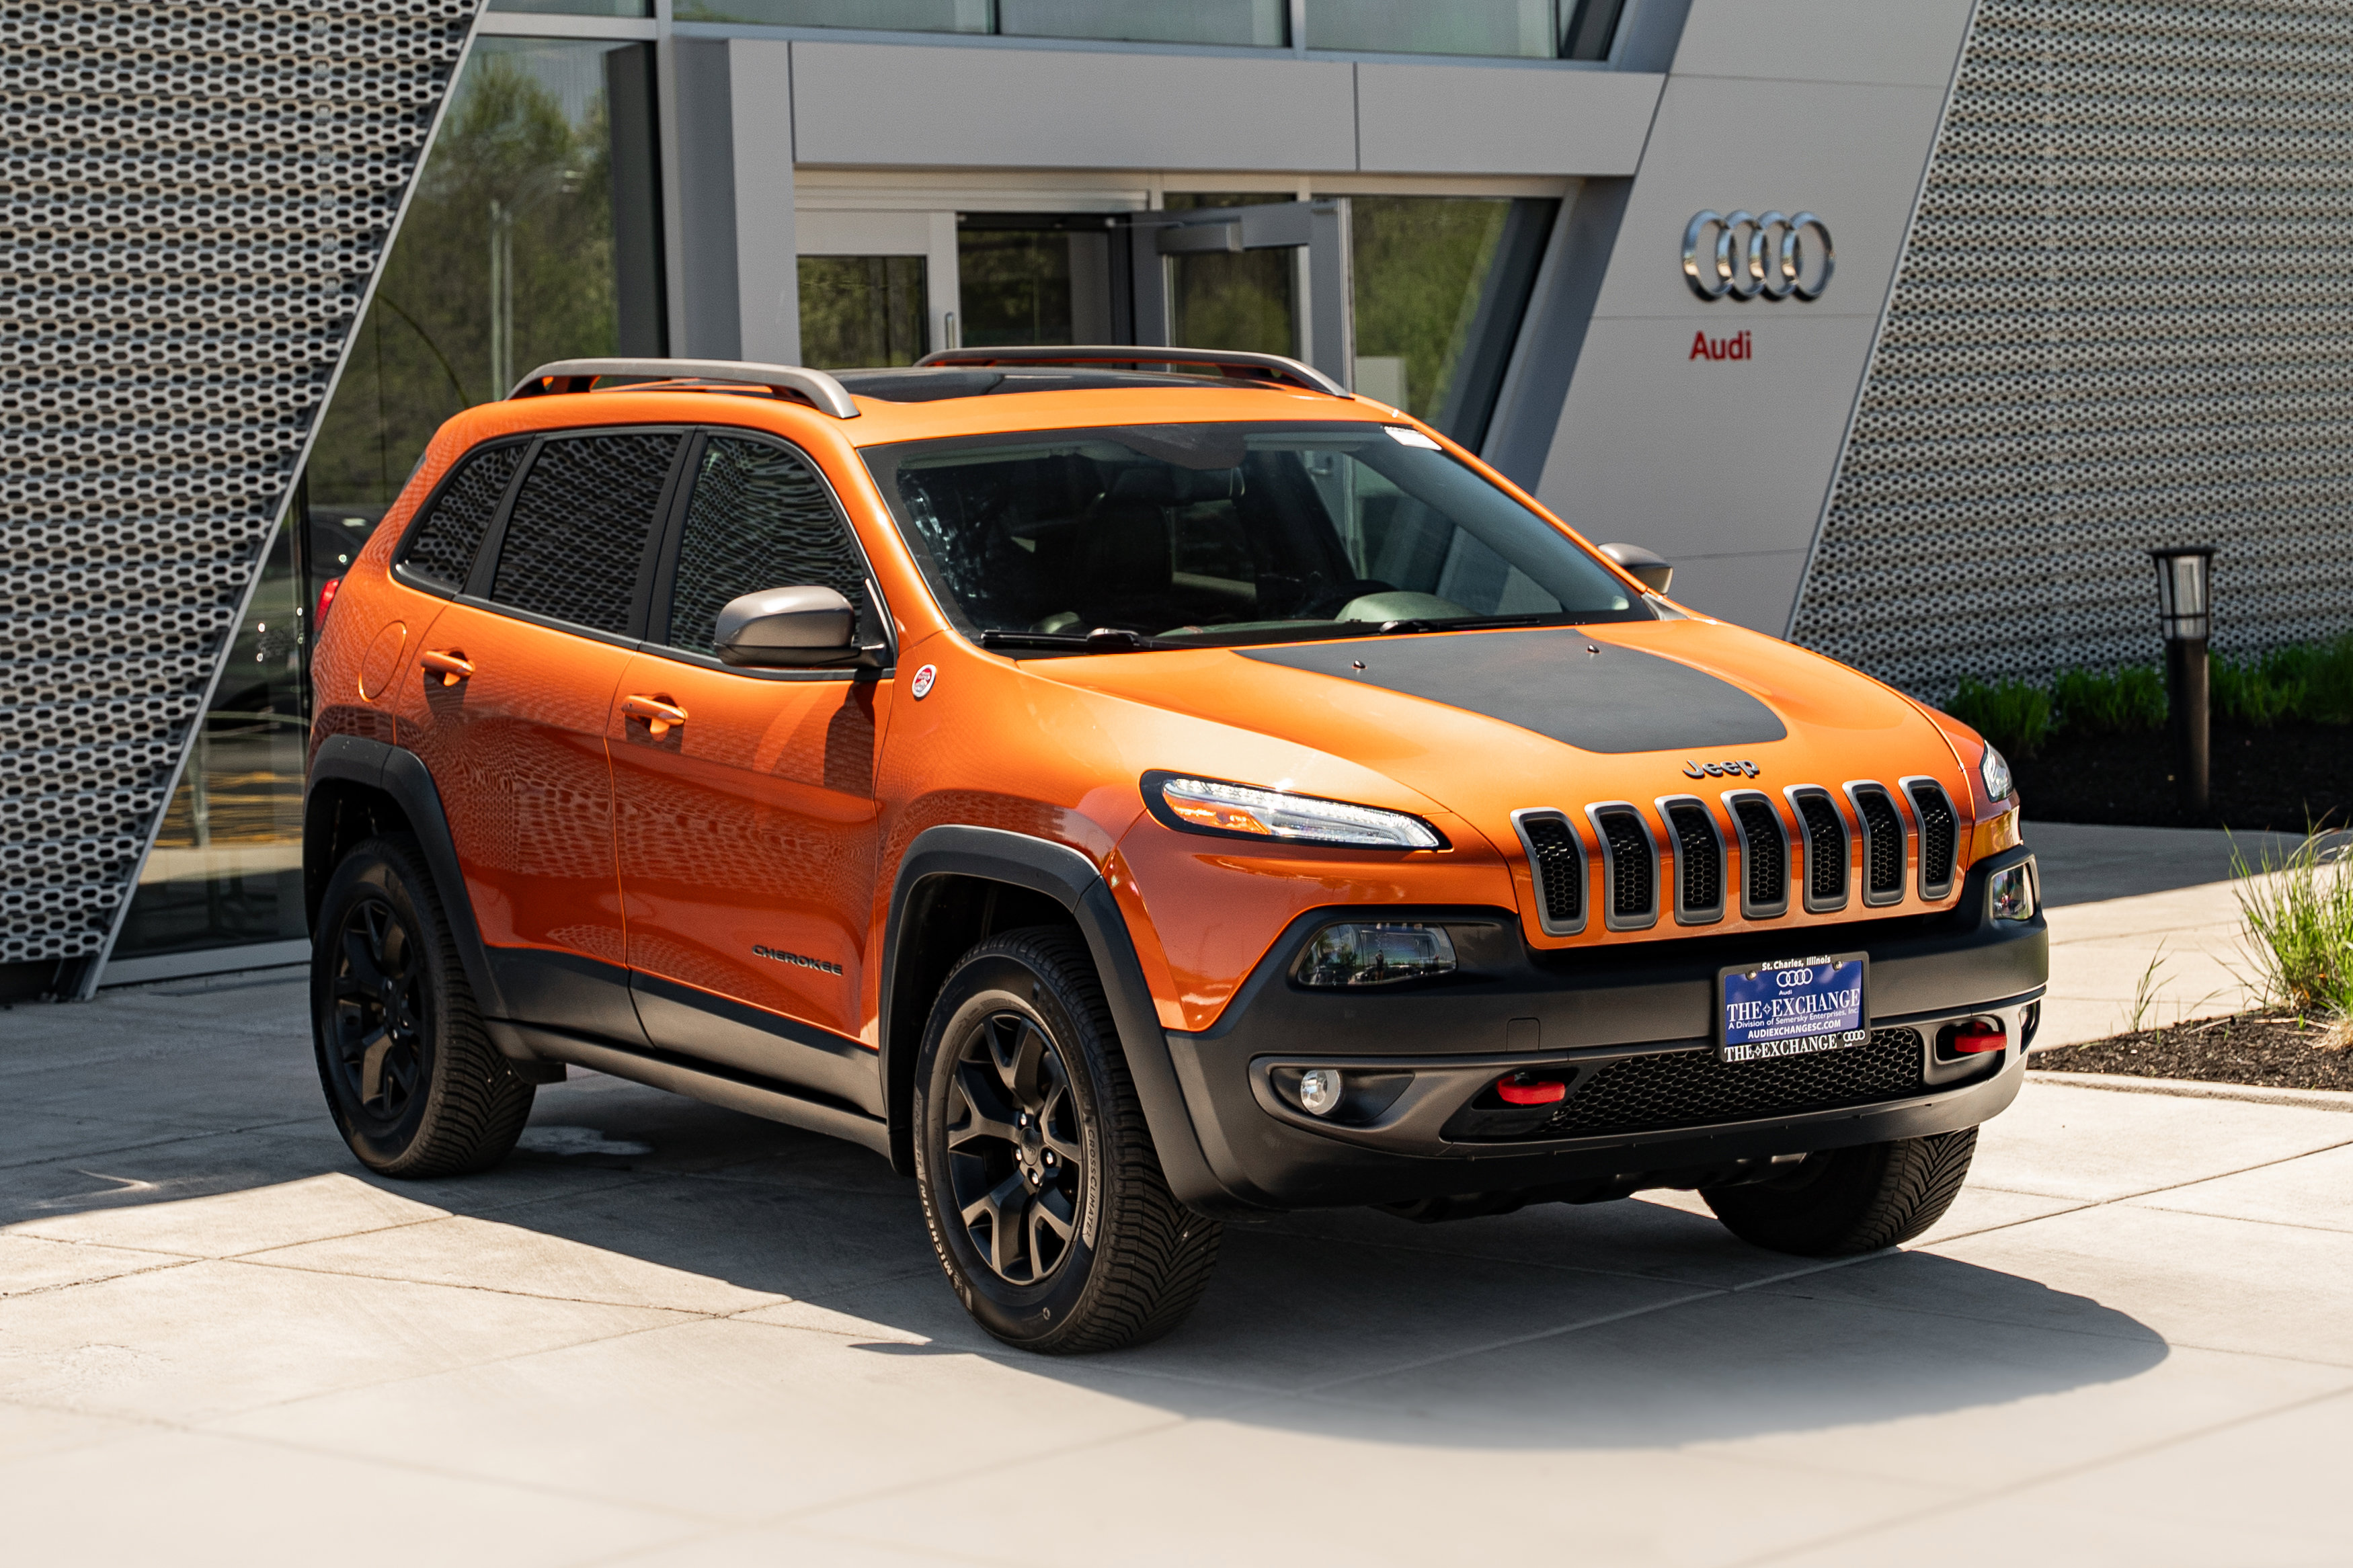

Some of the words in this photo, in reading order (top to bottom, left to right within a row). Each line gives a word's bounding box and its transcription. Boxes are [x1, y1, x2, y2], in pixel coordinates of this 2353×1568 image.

[1689, 330, 1751, 361] Audi
[1683, 759, 1760, 778] Jeep
[752, 944, 843, 976] CHEROKEE
[1761, 962, 1772, 971] St.
[1773, 958, 1804, 969] Charles,
[1806, 955, 1831, 966] Illinois
[1727, 1001, 1762, 1022] THE
[1771, 988, 1860, 1018] EXCHANGE
[1728, 1022, 1734, 1030] A
[1737, 1020, 1764, 1029] Division
[1766, 1018, 1774, 1026] of
[1776, 1015, 1808, 1025] Semersky
[1748, 1019, 1841, 1039] AUDIEXCHANGESC.COM
[1724, 1044, 1755, 1062] THE
[1761, 1034, 1837, 1058] EXCHANGE
[920, 1184, 953, 1276] MICHELIN
